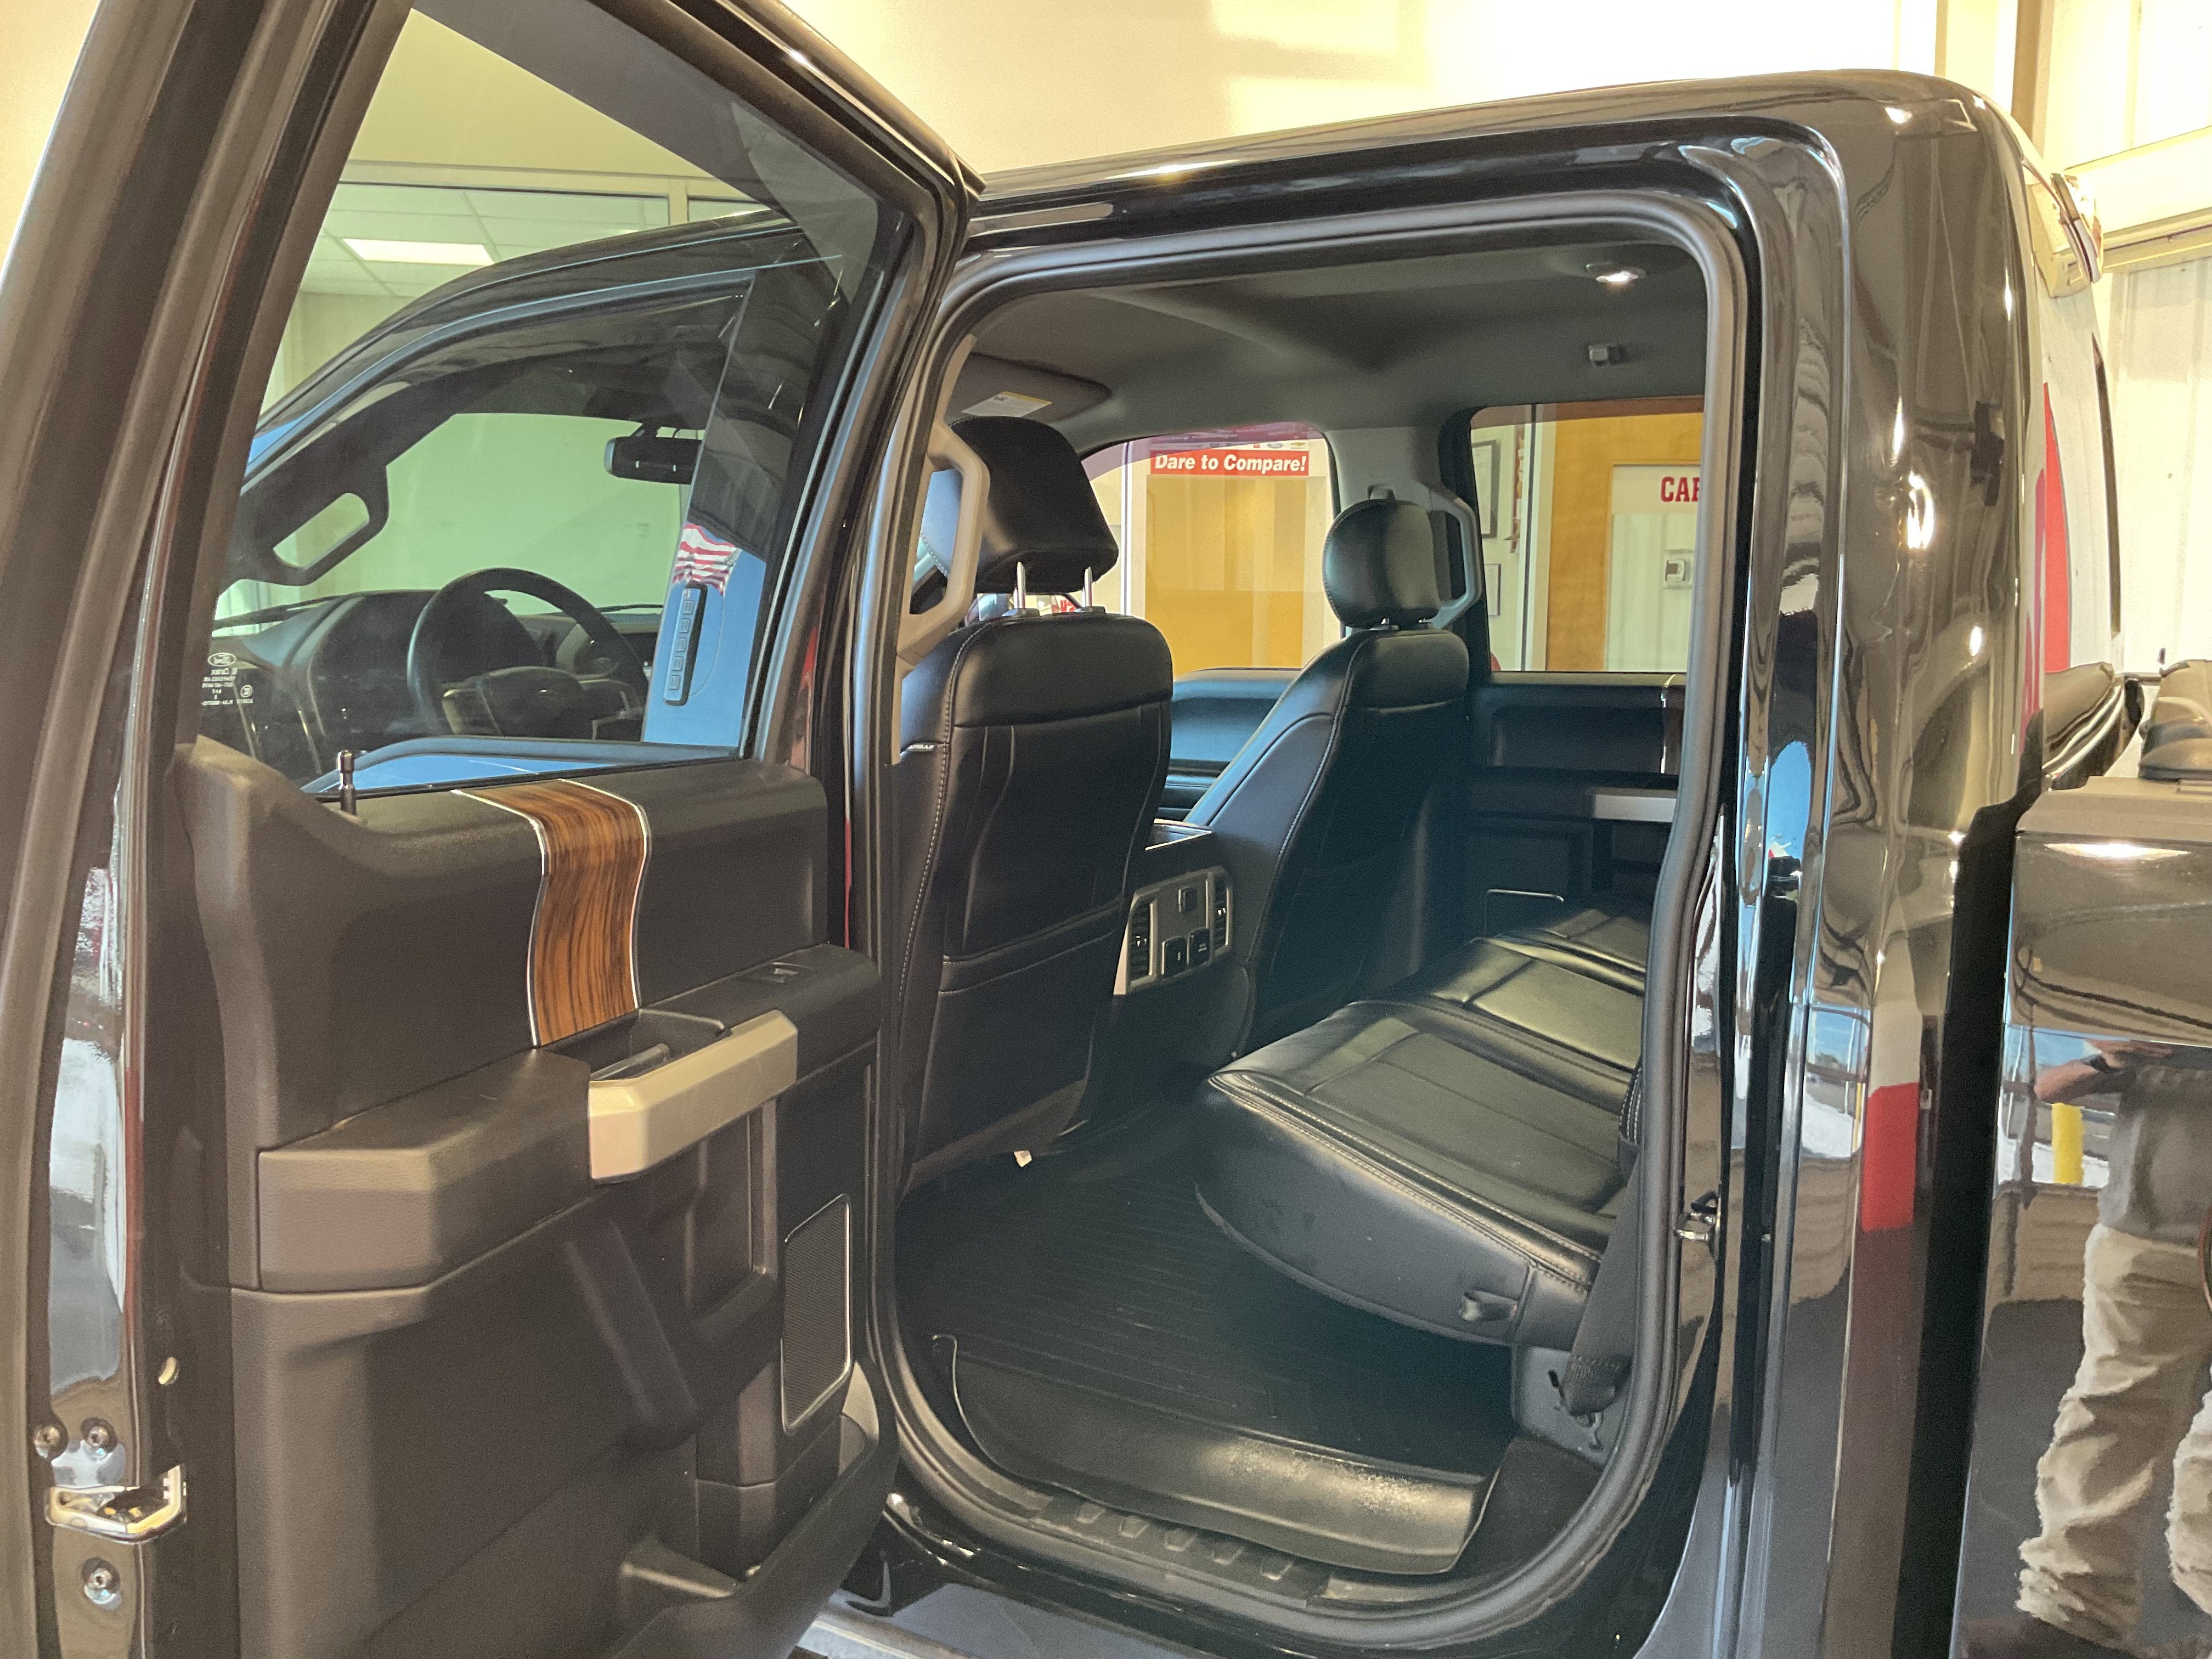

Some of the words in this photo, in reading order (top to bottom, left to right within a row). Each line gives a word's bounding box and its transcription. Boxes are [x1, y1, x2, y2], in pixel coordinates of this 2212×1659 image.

[1154, 454, 1195, 470] Dare
[1201, 454, 1218, 470] to
[1223, 454, 1307, 475] Compare!
